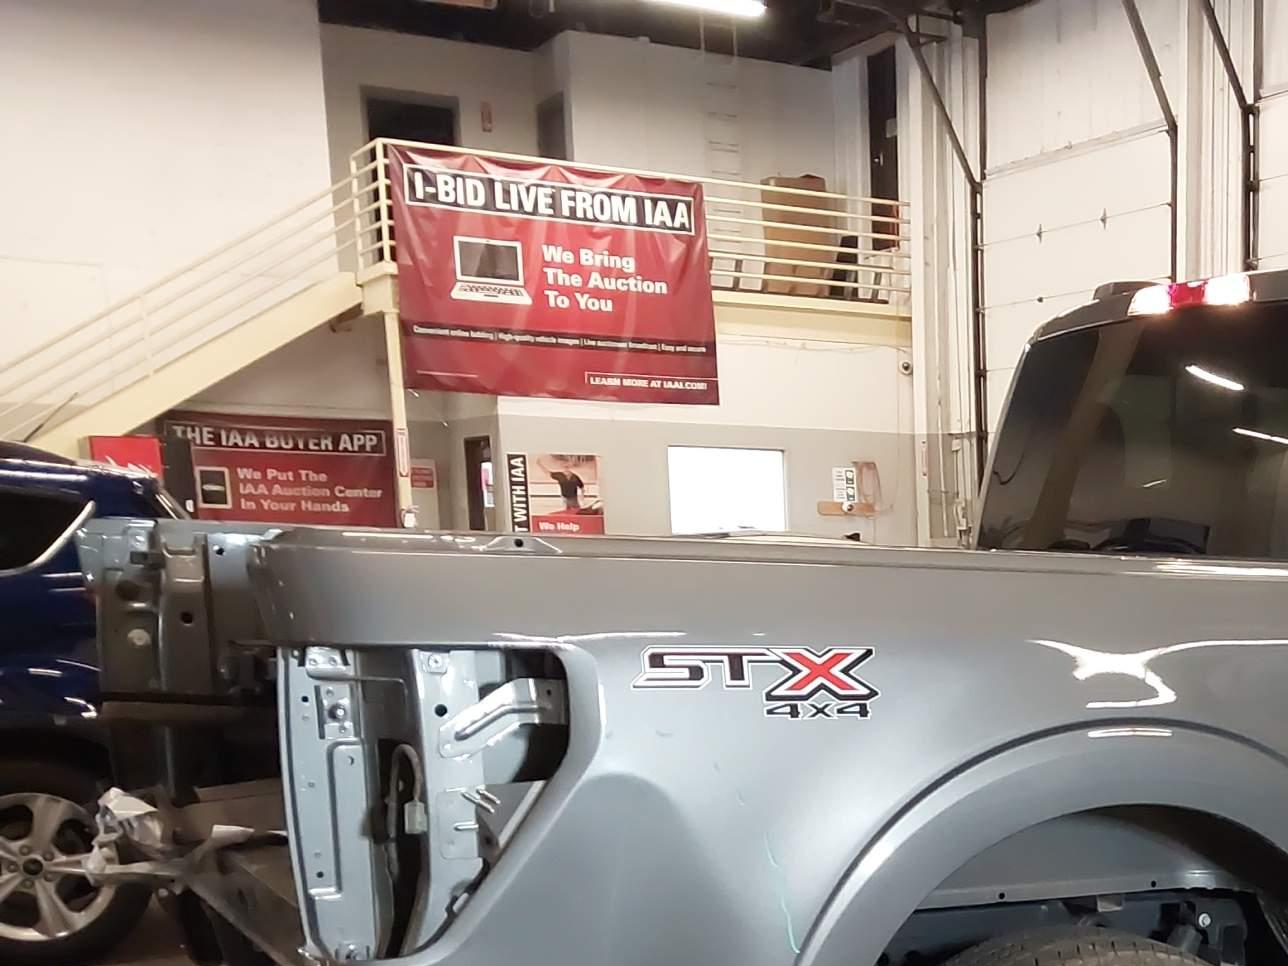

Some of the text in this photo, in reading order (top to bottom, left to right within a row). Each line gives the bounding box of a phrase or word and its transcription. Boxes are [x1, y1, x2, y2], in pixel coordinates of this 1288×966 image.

[414, 171, 690, 229] I-BID LIVE FROM IAA
[541, 244, 636, 273] We Bring
[542, 267, 668, 294] The Auction
[543, 289, 613, 312] To You
[589, 376, 621, 386] LEARN
[622, 377, 649, 388] MORE
[650, 379, 661, 388] AT
[172, 425, 216, 446] THE
[220, 428, 260, 449] IAA
[338, 433, 378, 452] APP
[236, 467, 328, 482] We Put The
[510, 457, 525, 481] IAA
[239, 483, 383, 498] IAA Auction Center
[240, 499, 350, 513] In Your Hands
[511, 485, 528, 522] WITH
[538, 521, 555, 530] We
[557, 522, 579, 532] Help
[630, 645, 881, 702] STX
